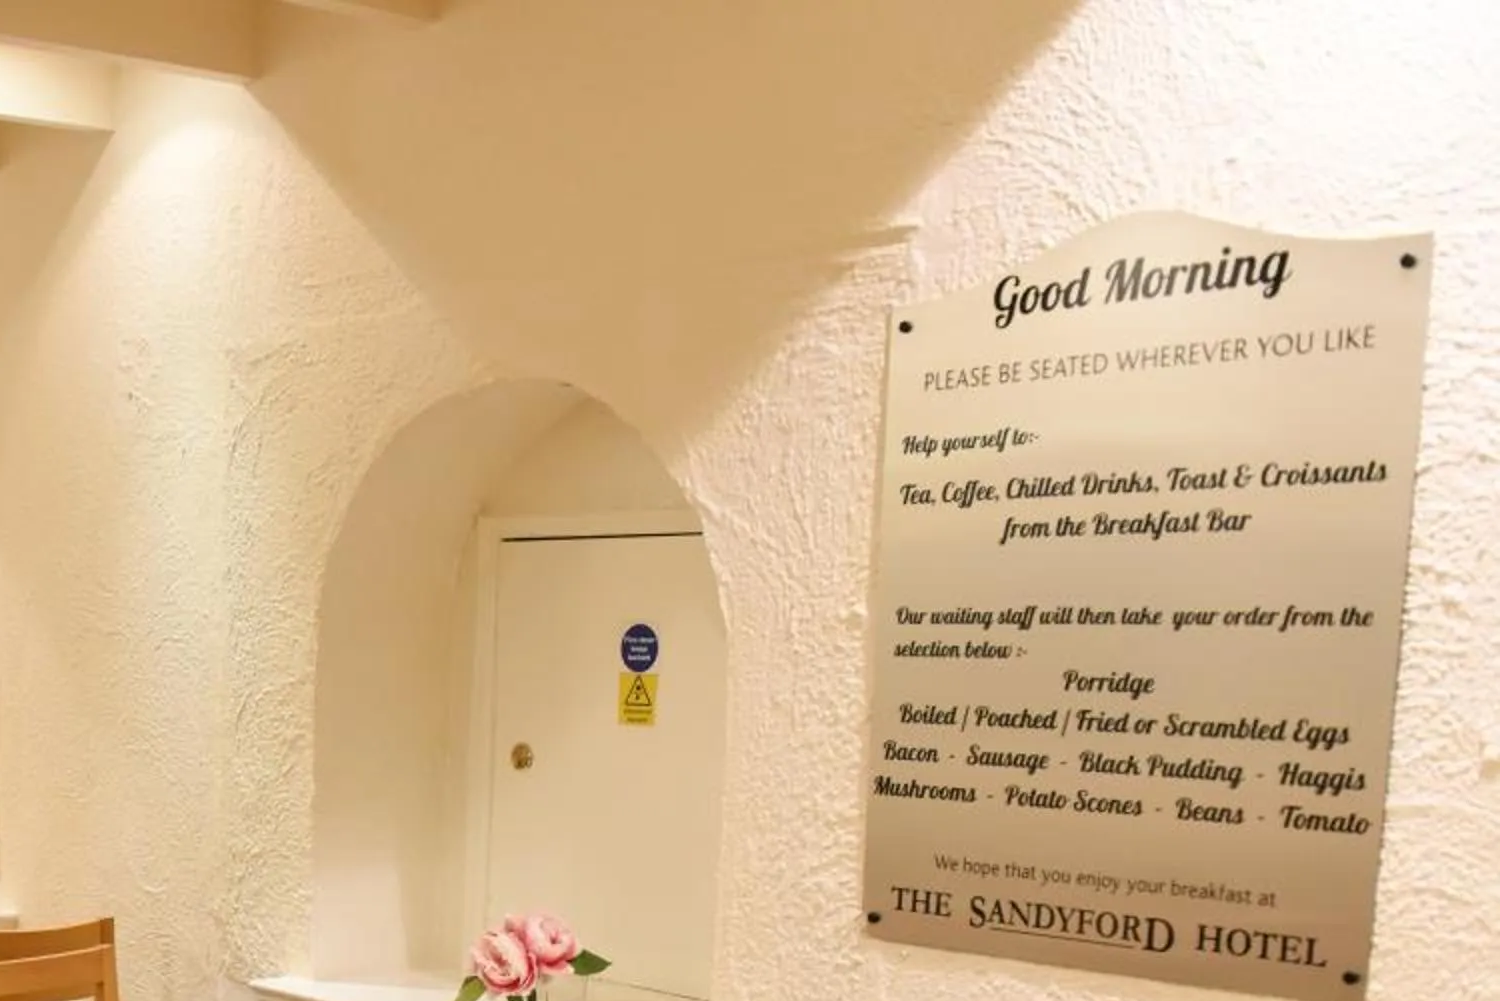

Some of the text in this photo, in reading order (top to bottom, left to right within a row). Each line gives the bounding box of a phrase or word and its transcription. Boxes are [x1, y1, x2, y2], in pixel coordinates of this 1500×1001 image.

[993, 246, 1293, 329] Good Morning
[923, 324, 1375, 392] PLEASE BE SEATED WHEREVER YOU LIKE
[902, 435, 939, 459] Help
[941, 427, 1011, 457] yourself
[1005, 475, 1076, 500] Chilled
[1166, 467, 1228, 492] Toast
[1232, 464, 1255, 489] &
[1260, 460, 1387, 488] Croissants
[999, 509, 1253, 546] from the Breakfast Bar
[895, 604, 1374, 633] Our waiting staff will then take your order from the
[893, 640, 961, 659] selection
[963, 640, 1013, 659] below
[1062, 669, 1155, 701] Porridge
[899, 703, 958, 726] Boiled
[974, 705, 1058, 731] Poached
[1075, 709, 1131, 734] Fried
[1133, 718, 1158, 735] or
[1163, 713, 1288, 742] Scrambled
[1291, 718, 1350, 752] Eggs
[883, 739, 940, 764] Bacon
[965, 744, 1049, 776] Sausage
[1078, 751, 1141, 776] Black
[1146, 754, 1243, 790] Pudding
[1278, 761, 1366, 797] Haggis
[873, 774, 977, 803] Mushrooms
[1004, 785, 1068, 810] Potato
[1072, 789, 1143, 817] Scones
[1175, 797, 1244, 825] Beans
[1279, 804, 1371, 836] Tomato
[934, 854, 1277, 909] We hope that you enjoy your breakfast at
[890, 886, 952, 918] THE
[1195, 924, 1327, 968] HOTEL
